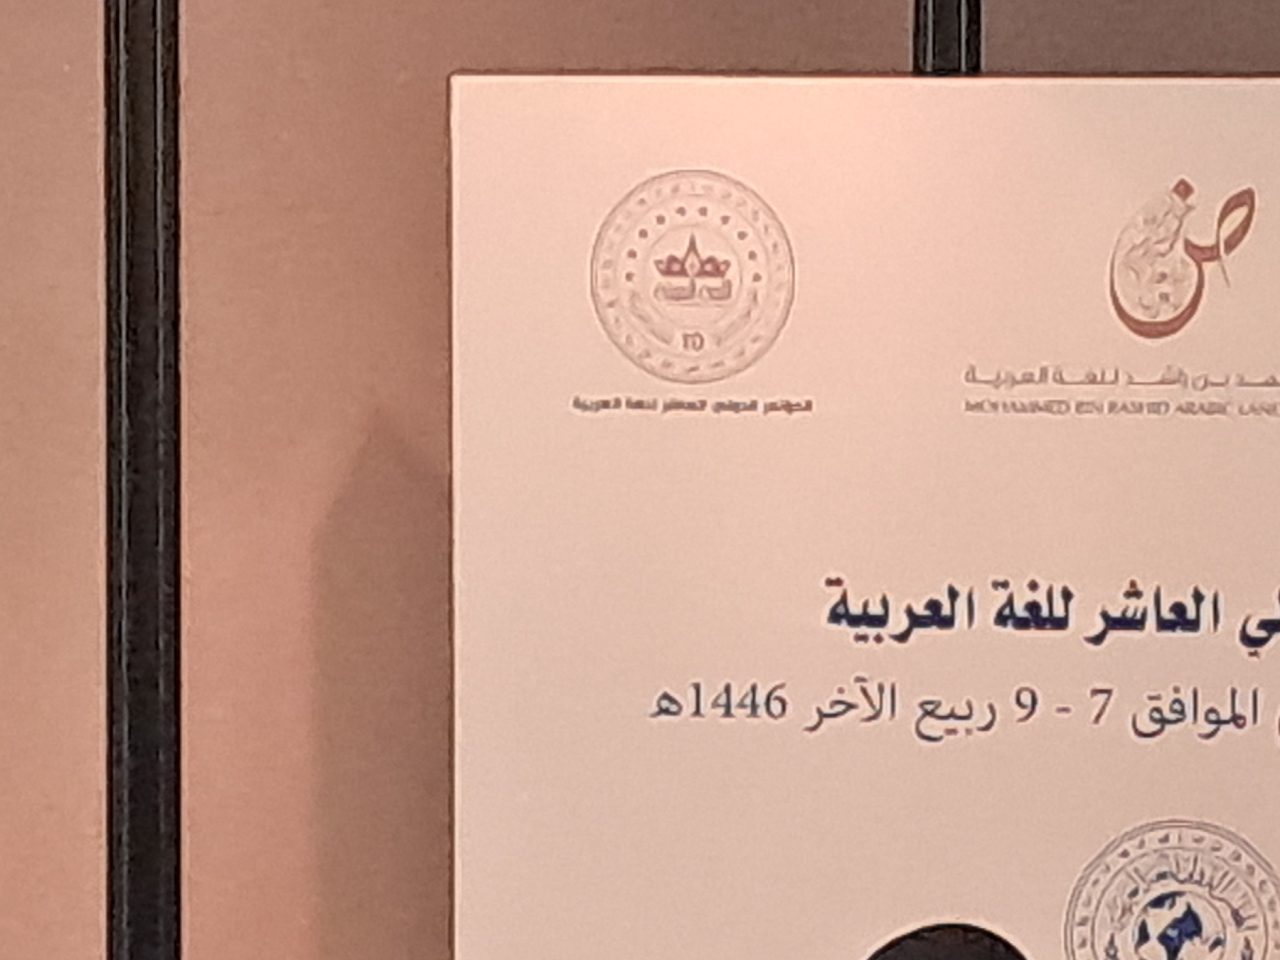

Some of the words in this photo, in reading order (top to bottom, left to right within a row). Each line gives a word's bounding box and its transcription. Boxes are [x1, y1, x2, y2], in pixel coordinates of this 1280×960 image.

[825, 577, 976, 645] العربية
[991, 579, 1074, 631] للغة
[1083, 579, 1220, 647] العاشر
[803, 676, 896, 733] الآخر
[913, 698, 998, 742] ربيع
[1013, 686, 1038, 723] 9
[1089, 687, 1114, 725] 7
[1131, 684, 1259, 740] الموافق
